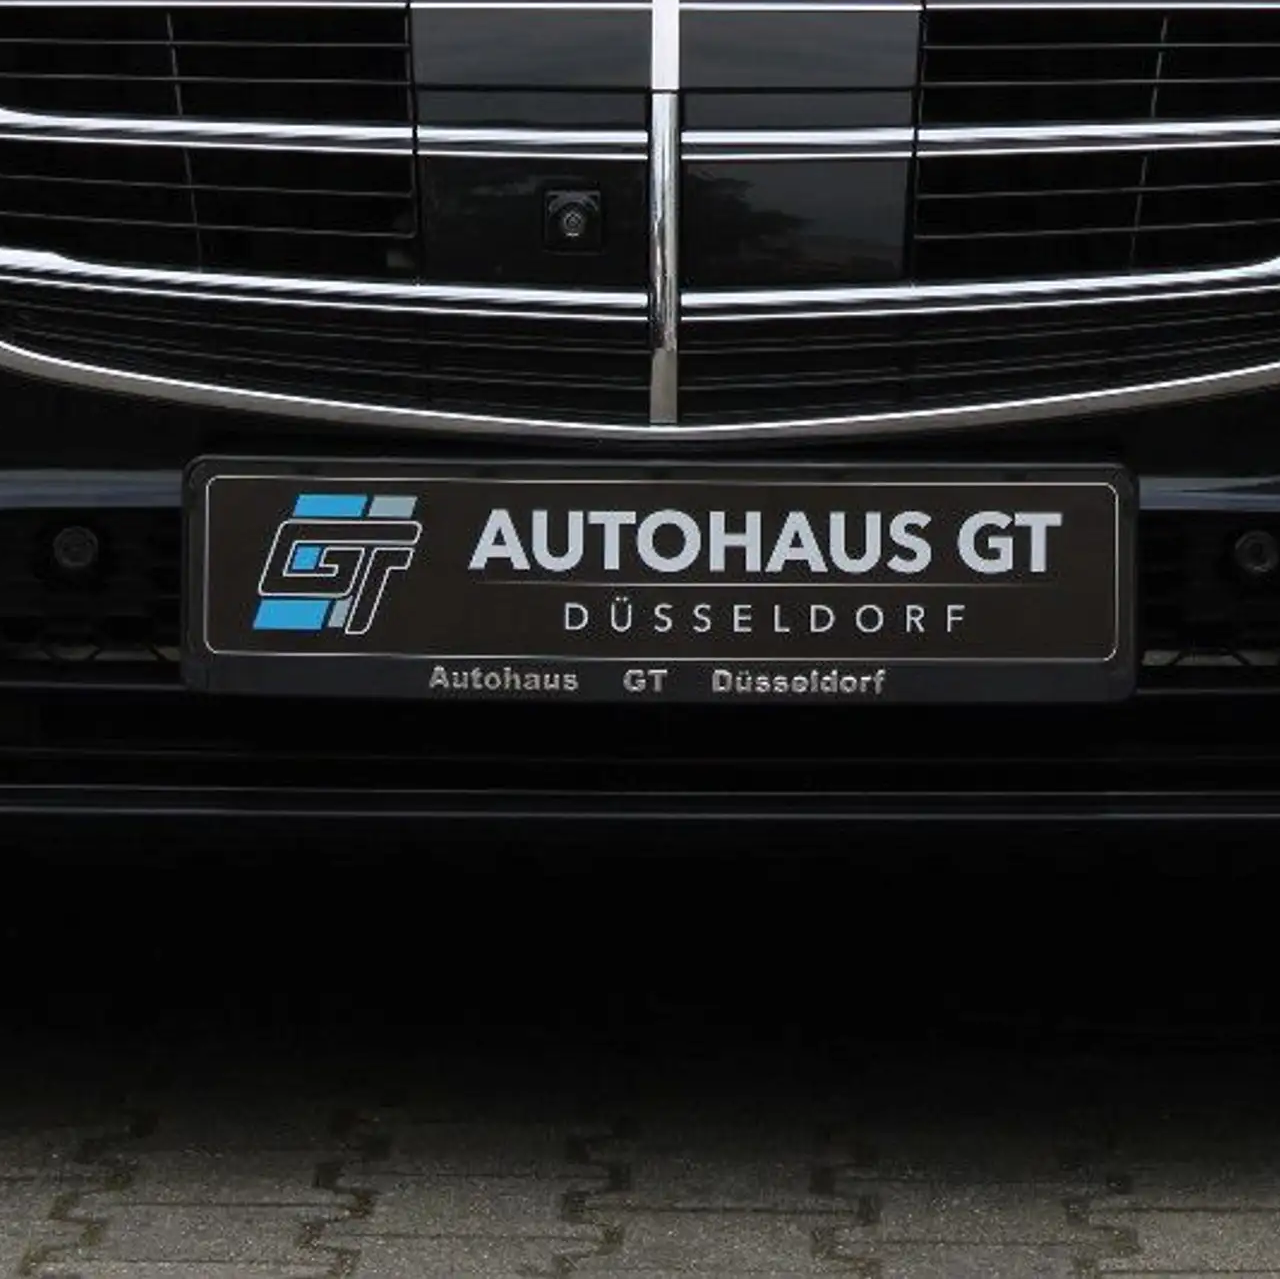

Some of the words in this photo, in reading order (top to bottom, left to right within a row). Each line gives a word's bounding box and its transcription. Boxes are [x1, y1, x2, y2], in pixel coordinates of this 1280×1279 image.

[468, 508, 933, 573] AUTOHAUS
[957, 510, 1063, 574] GT
[563, 596, 967, 633] DÜSSELDORF
[428, 665, 579, 691] Autohaus
[623, 668, 668, 692] GT
[711, 667, 886, 693] Düsseldorf
